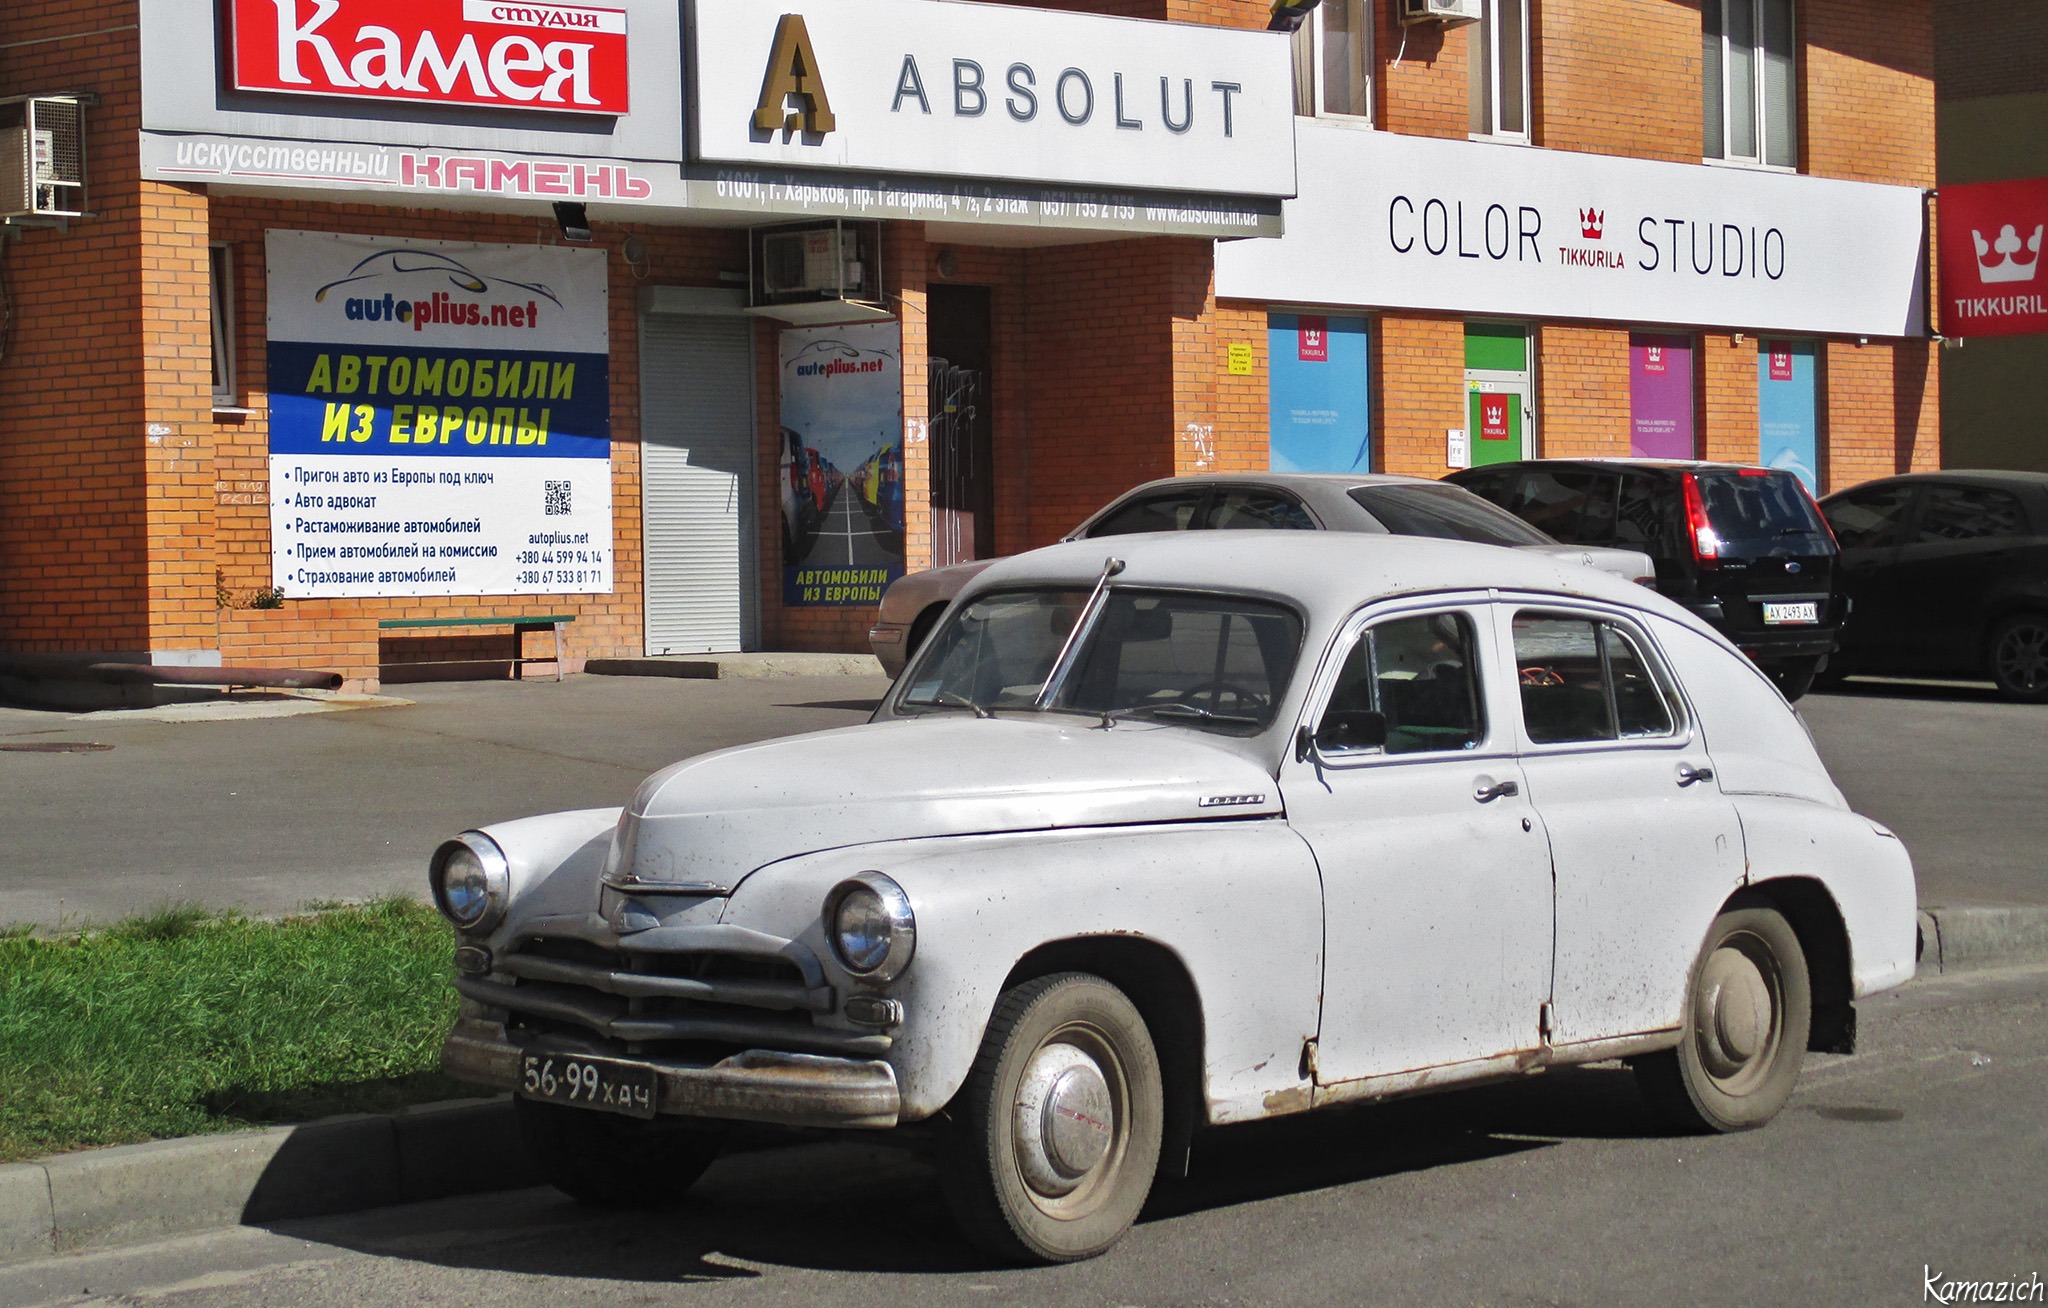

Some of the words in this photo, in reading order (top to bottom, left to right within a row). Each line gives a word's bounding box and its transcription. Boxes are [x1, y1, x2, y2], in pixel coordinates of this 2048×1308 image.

[491, 6, 600, 29] студия
[273, 0, 601, 105] Камея
[890, 54, 1241, 138] ABSOLUT
[175, 140, 388, 175] искусственный
[400, 154, 653, 200] КАМЕНЬ
[716, 170, 765, 205] 61001,
[769, 181, 781, 200] г.
[784, 175, 849, 210] Харьков,
[853, 185, 874, 211] пр.
[878, 180, 947, 215] Гагарина,
[983, 187, 992, 212] 2
[995, 194, 1029, 214] этаж
[1074, 191, 1097, 218] 755
[1101, 193, 1109, 219] 2
[1113, 195, 1135, 220] 755
[1146, 198, 1258, 226] www.absolut.in.ua
[1388, 195, 1542, 263] COLOR
[1638, 216, 1786, 281] STUDIO
[1559, 247, 1625, 270] TIKKURILA
[345, 292, 538, 331] autoplius.net
[305, 354, 576, 400] АВТОМОБИЛИ
[797, 358, 884, 378] autoplius.net
[321, 403, 375, 443] ИЗ
[388, 404, 551, 446] ЕВРОПЫ
[294, 467, 339, 484] Пригон
[343, 473, 370, 483] авто
[373, 473, 388, 484] из
[391, 468, 436, 487] Европы
[439, 475, 461, 486] под
[464, 472, 494, 484] ключ
[294, 492, 324, 508] Авто
[327, 495, 376, 510] адвокат
[295, 517, 400, 533] Растаможивание
[404, 517, 481, 533] автомобилей
[528, 531, 589, 547] autoplius.net
[297, 543, 336, 562] Прием
[340, 543, 419, 558] автомобилей
[422, 547, 436, 558] на
[440, 545, 498, 558] комиссию
[516, 551, 539, 564] +380
[542, 551, 553, 563] 44
[557, 551, 573, 563] 599
[576, 551, 588, 563] 94
[591, 551, 602, 563] 14
[298, 568, 374, 587] Страхование
[378, 567, 456, 583] автомобилей
[516, 571, 539, 584] +380
[542, 571, 553, 583] 67
[557, 571, 574, 583] 533
[577, 571, 587, 583] 81
[591, 571, 601, 583] 71
[796, 568, 888, 586] АВТОМОБИЛИ
[803, 587, 821, 601] ИЗ
[825, 587, 881, 601] ЕВРОПЫ
[1769, 606, 1781, 619] AX
[1783, 606, 1801, 619] 2493
[1802, 605, 1815, 618] AX
